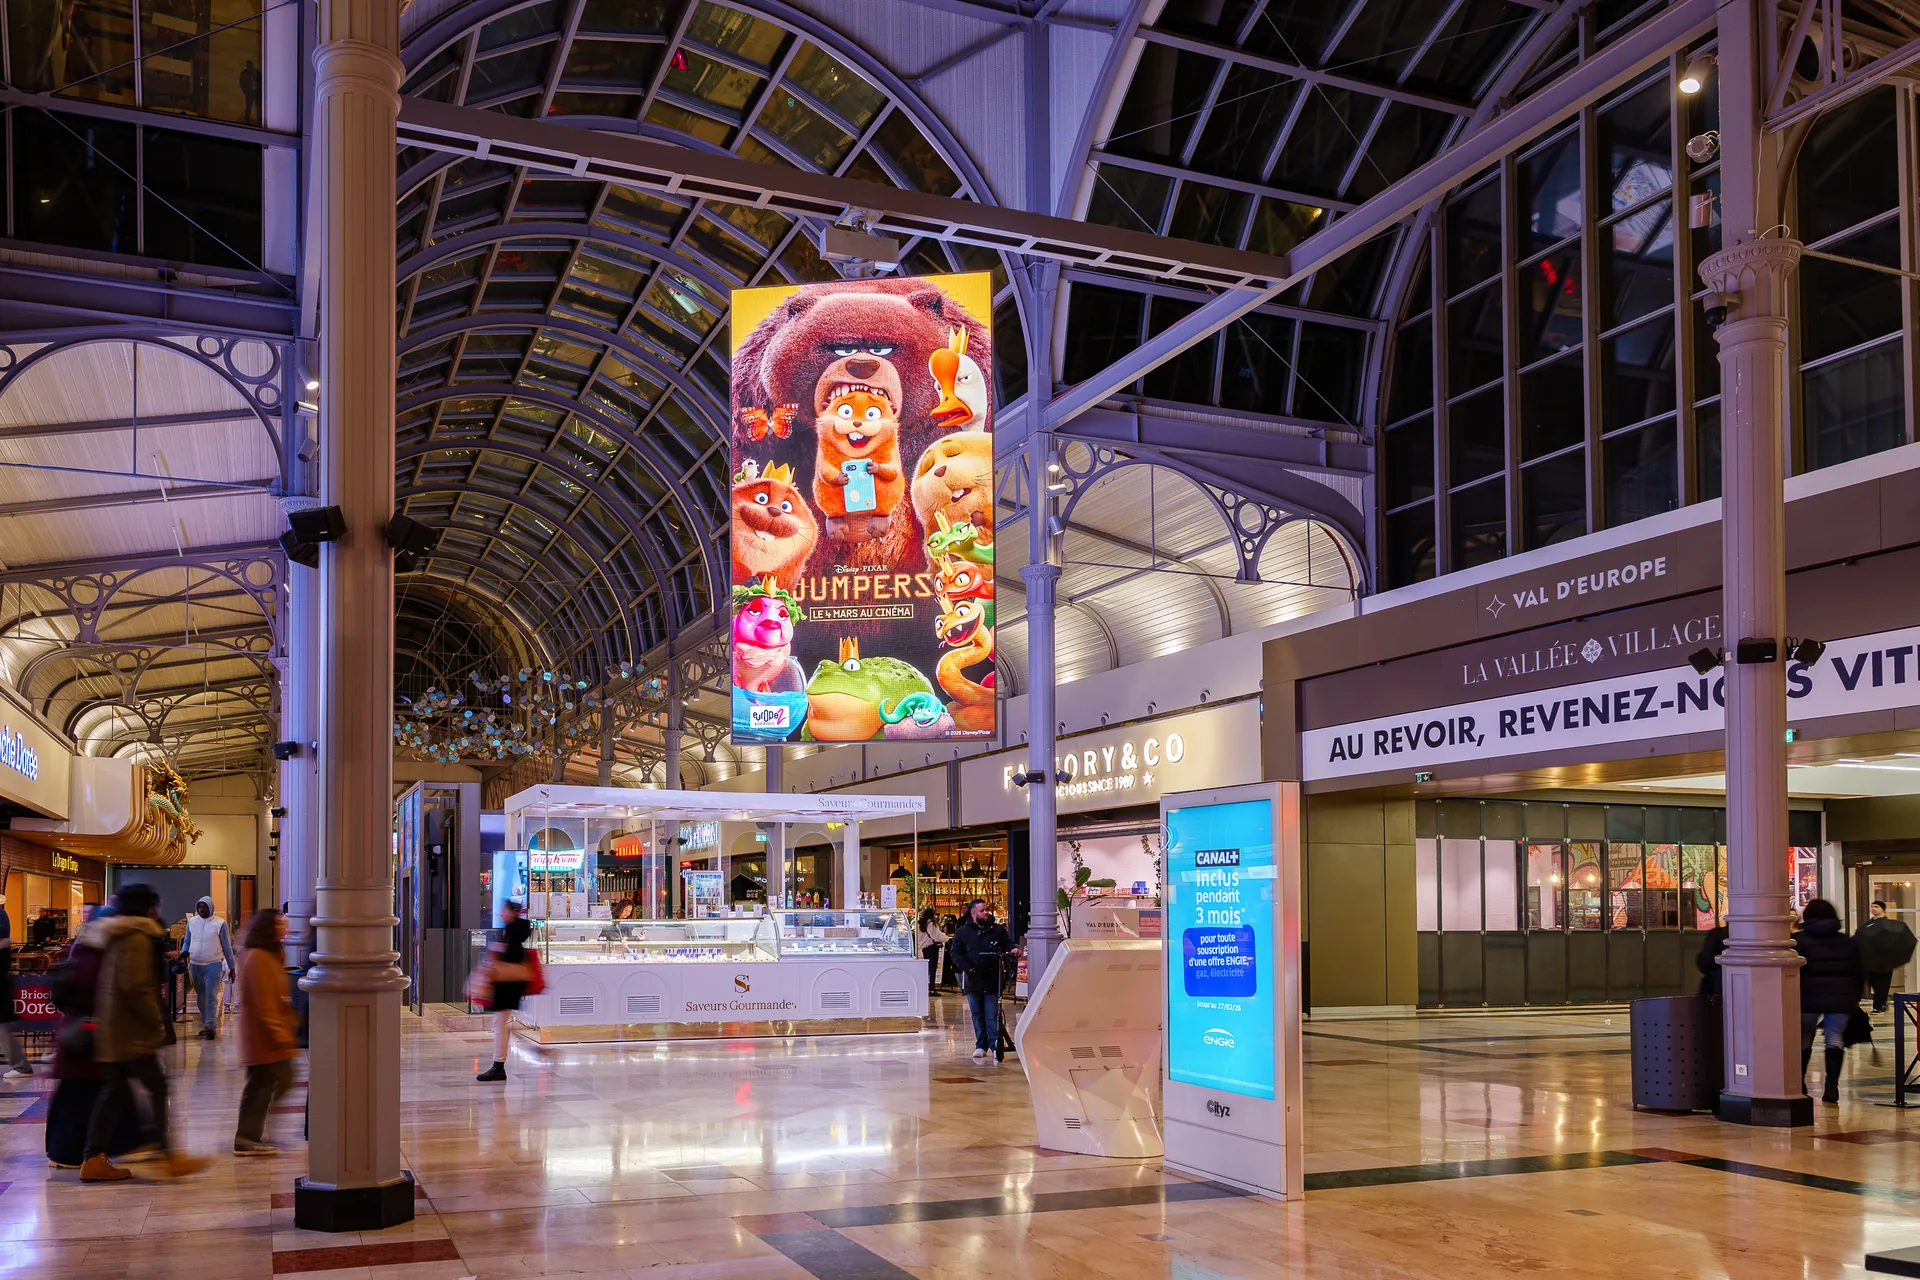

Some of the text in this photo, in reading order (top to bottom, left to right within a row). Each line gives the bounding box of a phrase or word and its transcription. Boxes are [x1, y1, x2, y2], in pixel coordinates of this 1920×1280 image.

[833, 564, 888, 575] Disney PIXAR
[793, 573, 932, 601] JUMPERS
[1512, 556, 1667, 610] VAL D'EUROPE
[813, 605, 911, 619] LE 4 MARS AU CINÉMA
[1462, 614, 1722, 685] LA VALLÉE VILLAGE
[1329, 643, 1920, 763] AU REVOIR, REVENEZ-NS VIT
[1196, 851, 1239, 865] CANAL+
[1196, 869, 1240, 887] inclus
[1195, 888, 1240, 905] pendant
[1195, 906, 1204, 924] 3
[1200, 933, 1236, 945] pour toute
[1197, 944, 1239, 955] souscription
[1188, 957, 1207, 967] d'une
[1207, 956, 1225, 966] offre
[1195, 968, 1245, 979] gaz, électricité
[685, 1001, 728, 1012] Saveurs
[1206, 1099, 1231, 1118] Cityz
